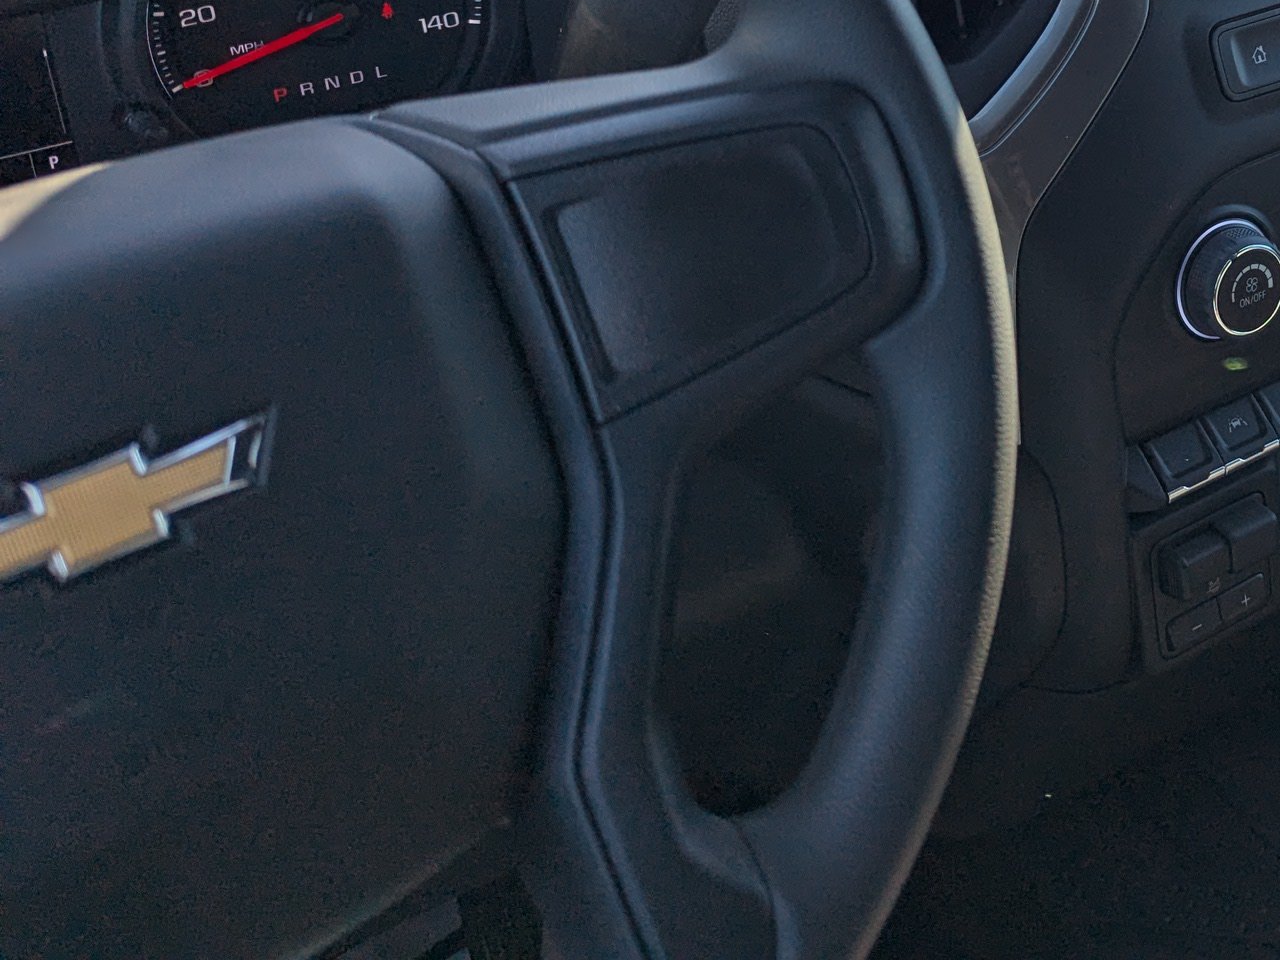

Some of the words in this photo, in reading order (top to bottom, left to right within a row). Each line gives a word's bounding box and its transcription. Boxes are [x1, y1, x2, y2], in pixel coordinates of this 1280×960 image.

[178, 5, 217, 27] 20
[418, 11, 461, 33] 140
[273, 87, 288, 103] P
[300, 81, 315, 96] R
[324, 75, 341, 91] N
[350, 69, 364, 85] D
[375, 66, 388, 78] L
[48, 155, 59, 170] P
[1239, 291, 1267, 308] ON/OFF
